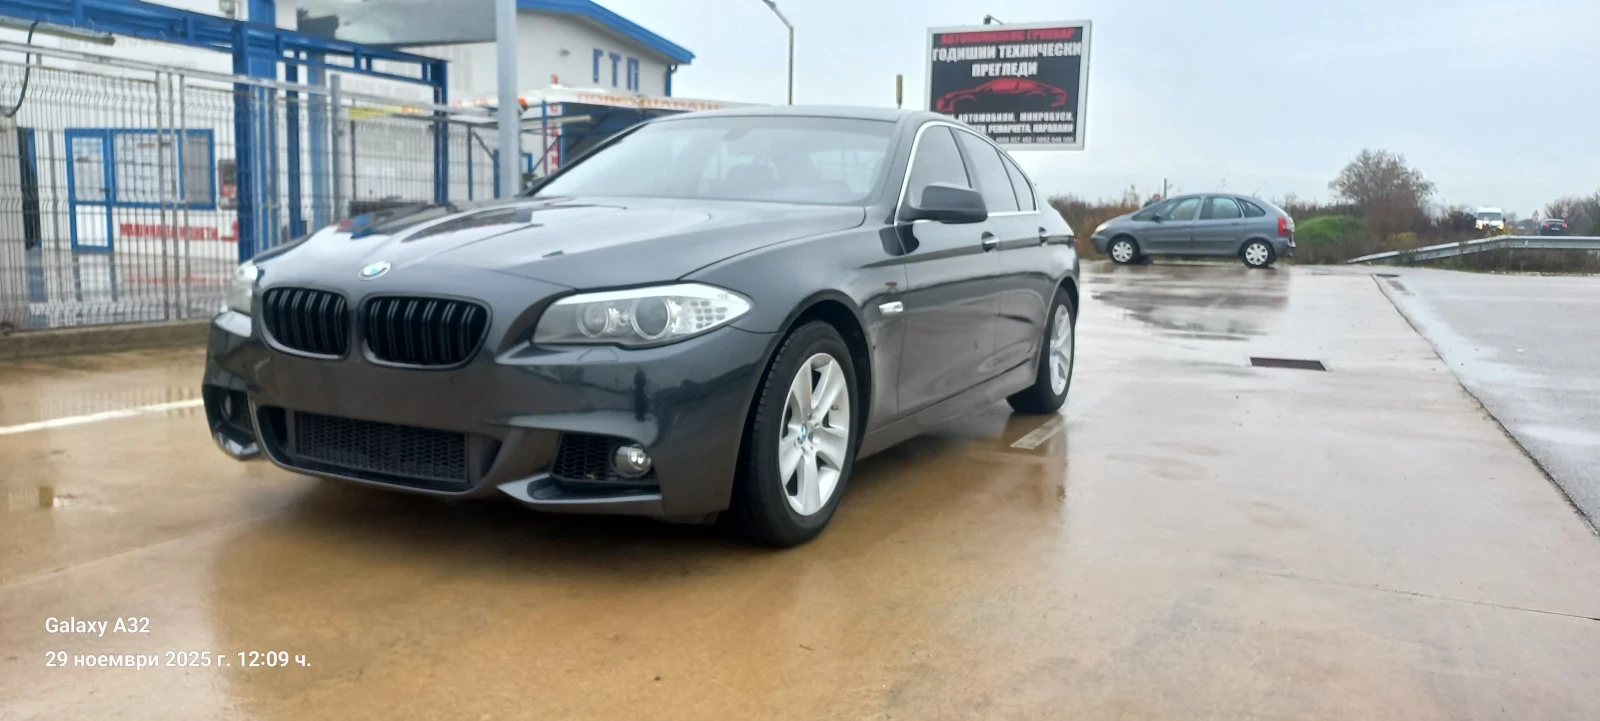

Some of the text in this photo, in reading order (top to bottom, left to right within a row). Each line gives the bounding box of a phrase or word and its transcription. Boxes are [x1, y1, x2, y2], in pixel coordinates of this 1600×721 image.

[932, 41, 1081, 62] ГОДИШНИ ТЕХНИЧЕСКИ
[593, 48, 640, 92] ГТП
[971, 61, 1038, 77] ПРЕГЛЕДИ
